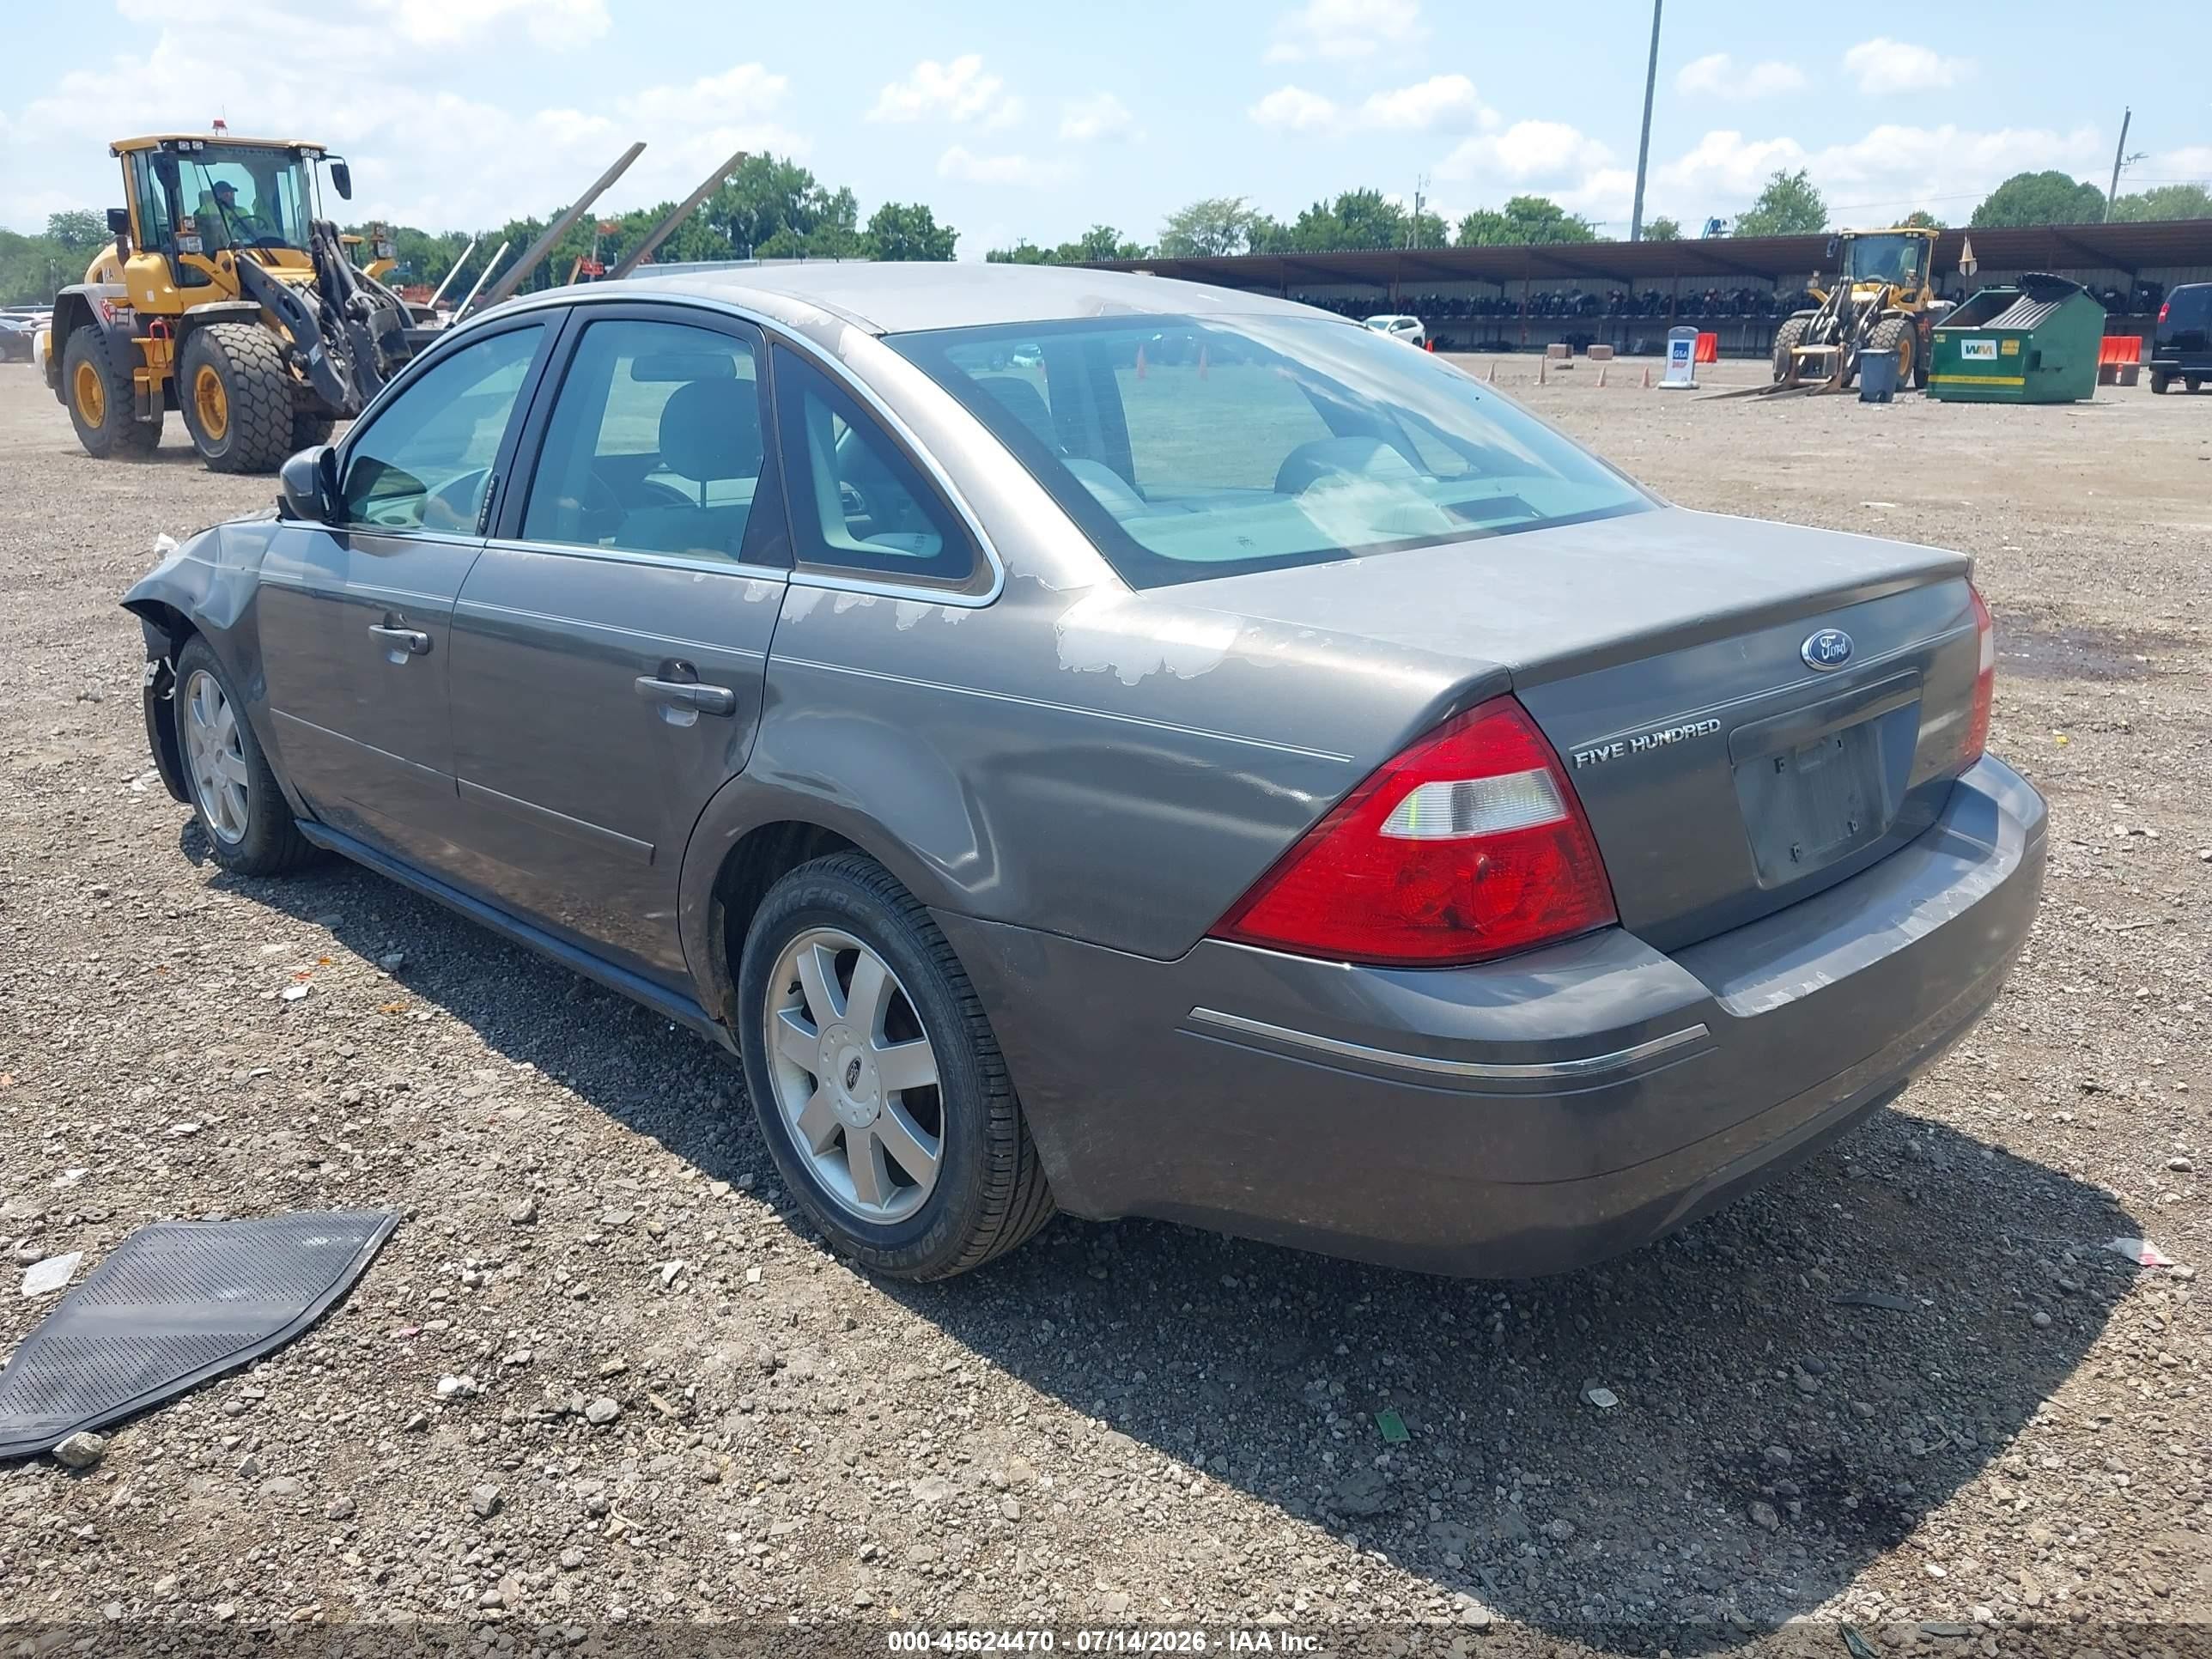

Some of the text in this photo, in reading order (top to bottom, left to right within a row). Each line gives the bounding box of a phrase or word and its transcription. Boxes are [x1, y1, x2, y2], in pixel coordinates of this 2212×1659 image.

[1966, 345, 1992, 355] WM
[1820, 635, 1848, 659] Ford
[1573, 718, 1721, 769] FIVE HUNDRED
